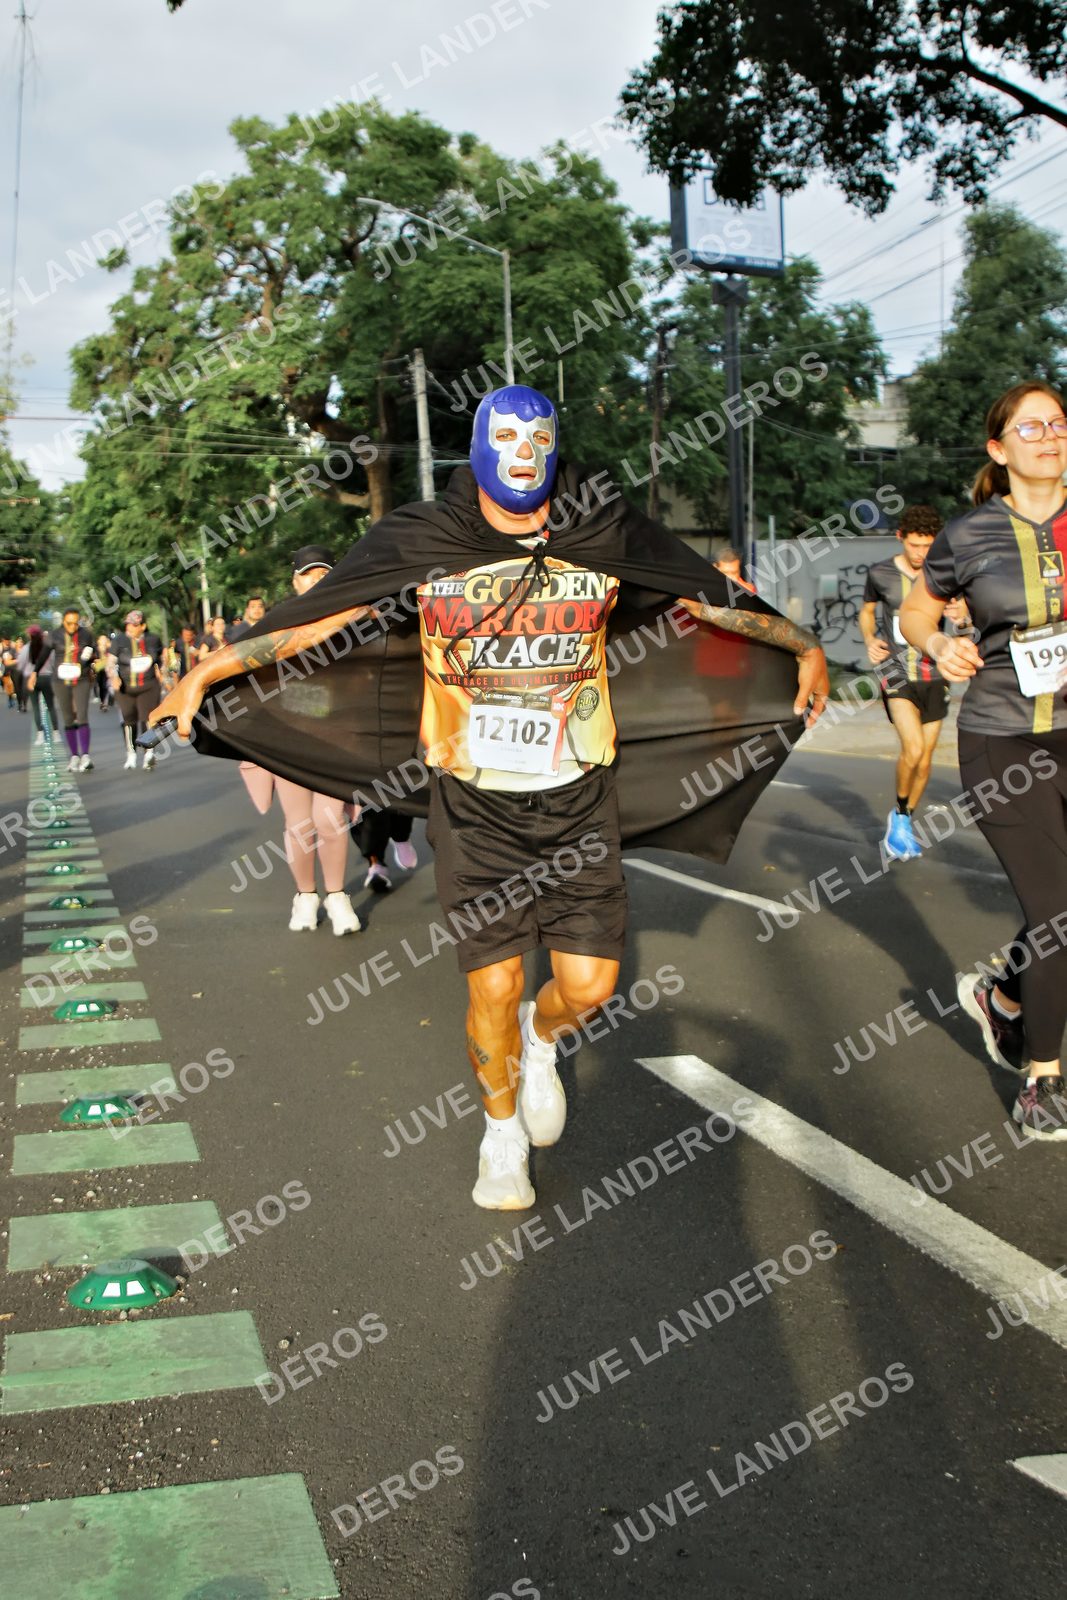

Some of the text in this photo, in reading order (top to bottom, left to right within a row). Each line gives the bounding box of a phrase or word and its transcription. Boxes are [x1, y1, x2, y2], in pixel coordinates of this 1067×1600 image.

[432, 571, 607, 604] THE GOLDEN
[418, 597, 602, 637] WARRIOR
[470, 633, 582, 668] RACE
[447, 675, 461, 684] THE
[463, 676, 488, 687] RACE
[493, 676, 505, 686] OF
[475, 714, 552, 746] 12102
